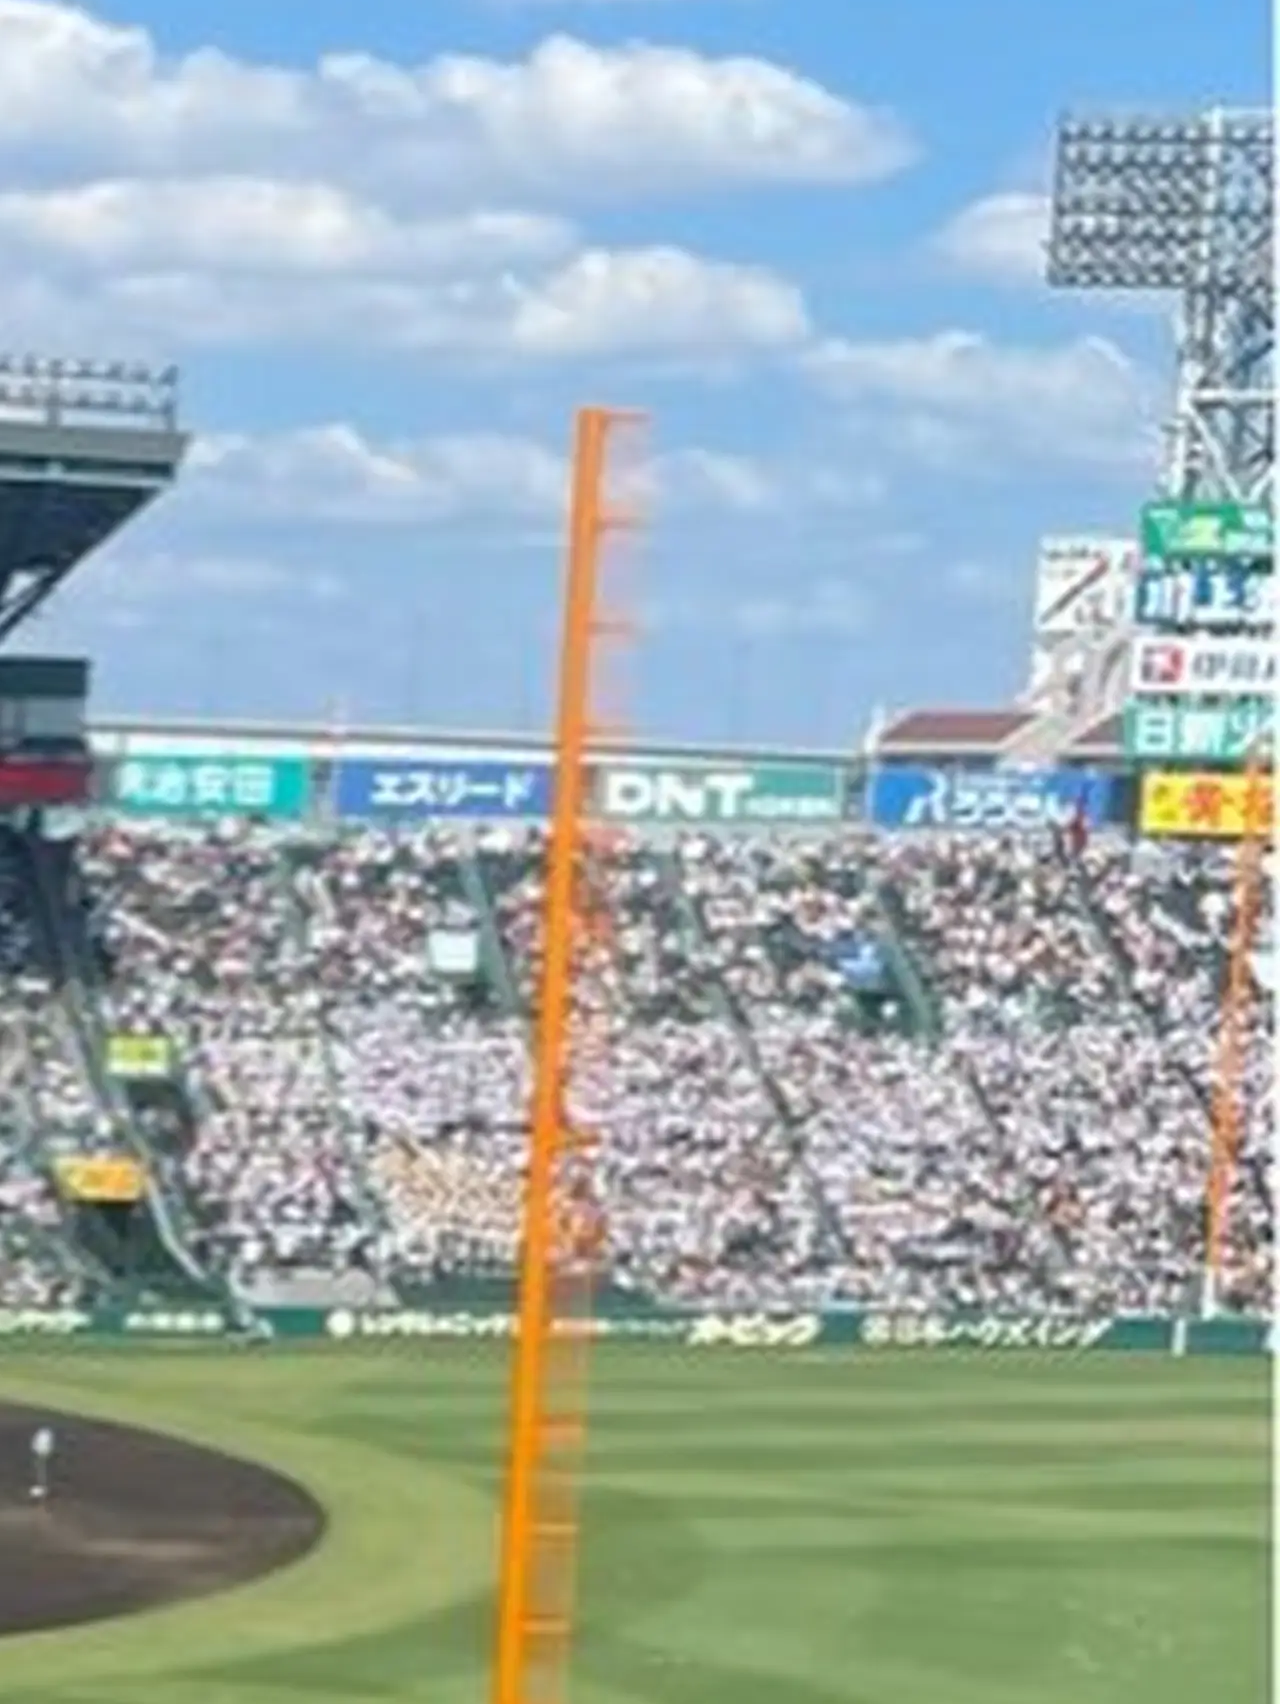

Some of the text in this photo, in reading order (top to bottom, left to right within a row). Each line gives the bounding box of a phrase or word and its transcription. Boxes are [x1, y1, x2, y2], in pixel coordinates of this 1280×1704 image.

[370, 770, 534, 807] エスリード
[604, 771, 754, 818] DNT
